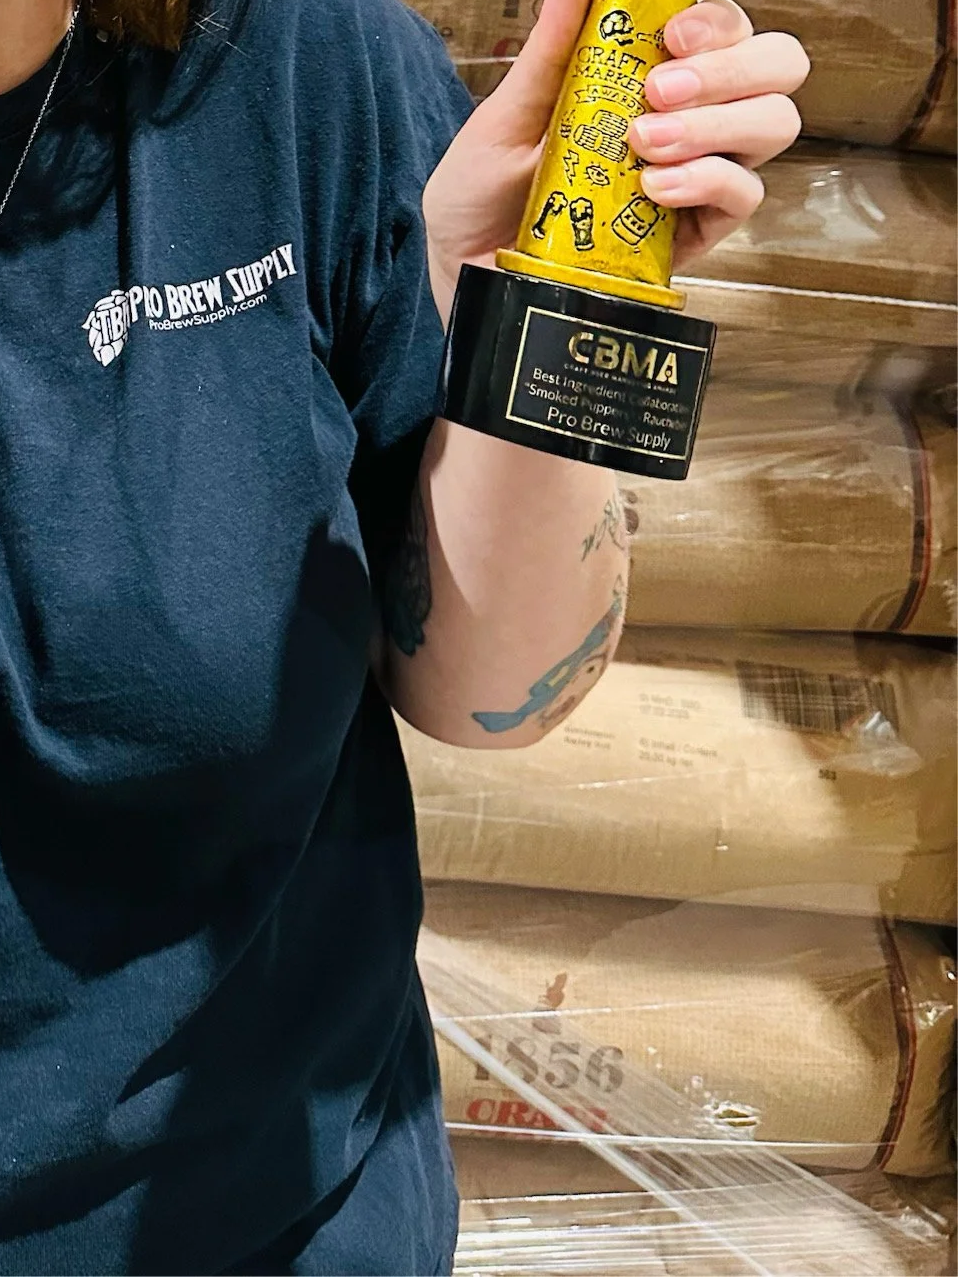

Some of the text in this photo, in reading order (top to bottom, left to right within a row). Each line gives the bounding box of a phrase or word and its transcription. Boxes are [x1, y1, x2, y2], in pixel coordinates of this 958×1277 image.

[577, 46, 647, 76] CRAFT
[572, 64, 646, 98] MARKET
[591, 87, 642, 114] AWARDS
[225, 243, 297, 304] SUPPLY
[149, 293, 267, 331] ProBrewSupply.com
[533, 367, 560, 385] Best
[568, 331, 678, 385] CBMA
[547, 406, 671, 451] Pro Brew Supply
